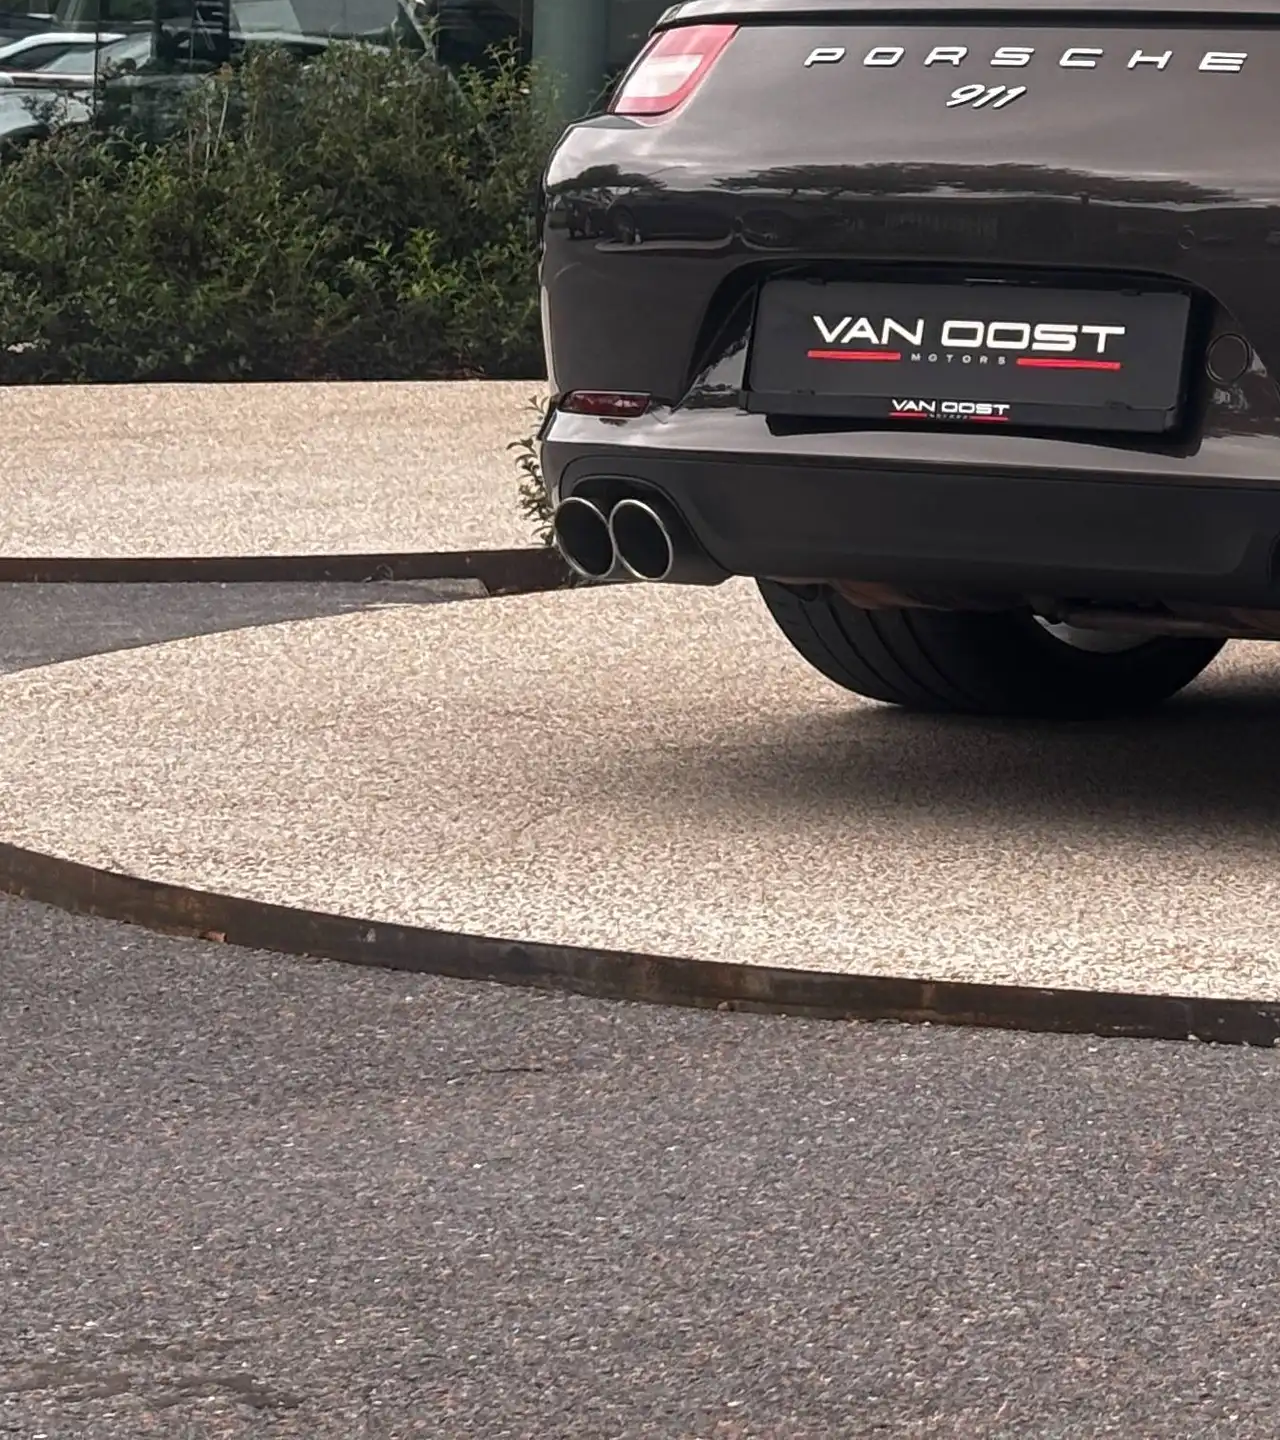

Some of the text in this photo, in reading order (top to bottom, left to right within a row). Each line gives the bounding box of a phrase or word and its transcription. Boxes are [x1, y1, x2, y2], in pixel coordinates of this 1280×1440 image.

[803, 46, 1249, 72] PORSCHE
[945, 83, 1028, 109] 911
[812, 315, 1126, 354] VAN OOST
[911, 353, 1006, 365] MOTORS
[891, 399, 1010, 415] VAN OOST
